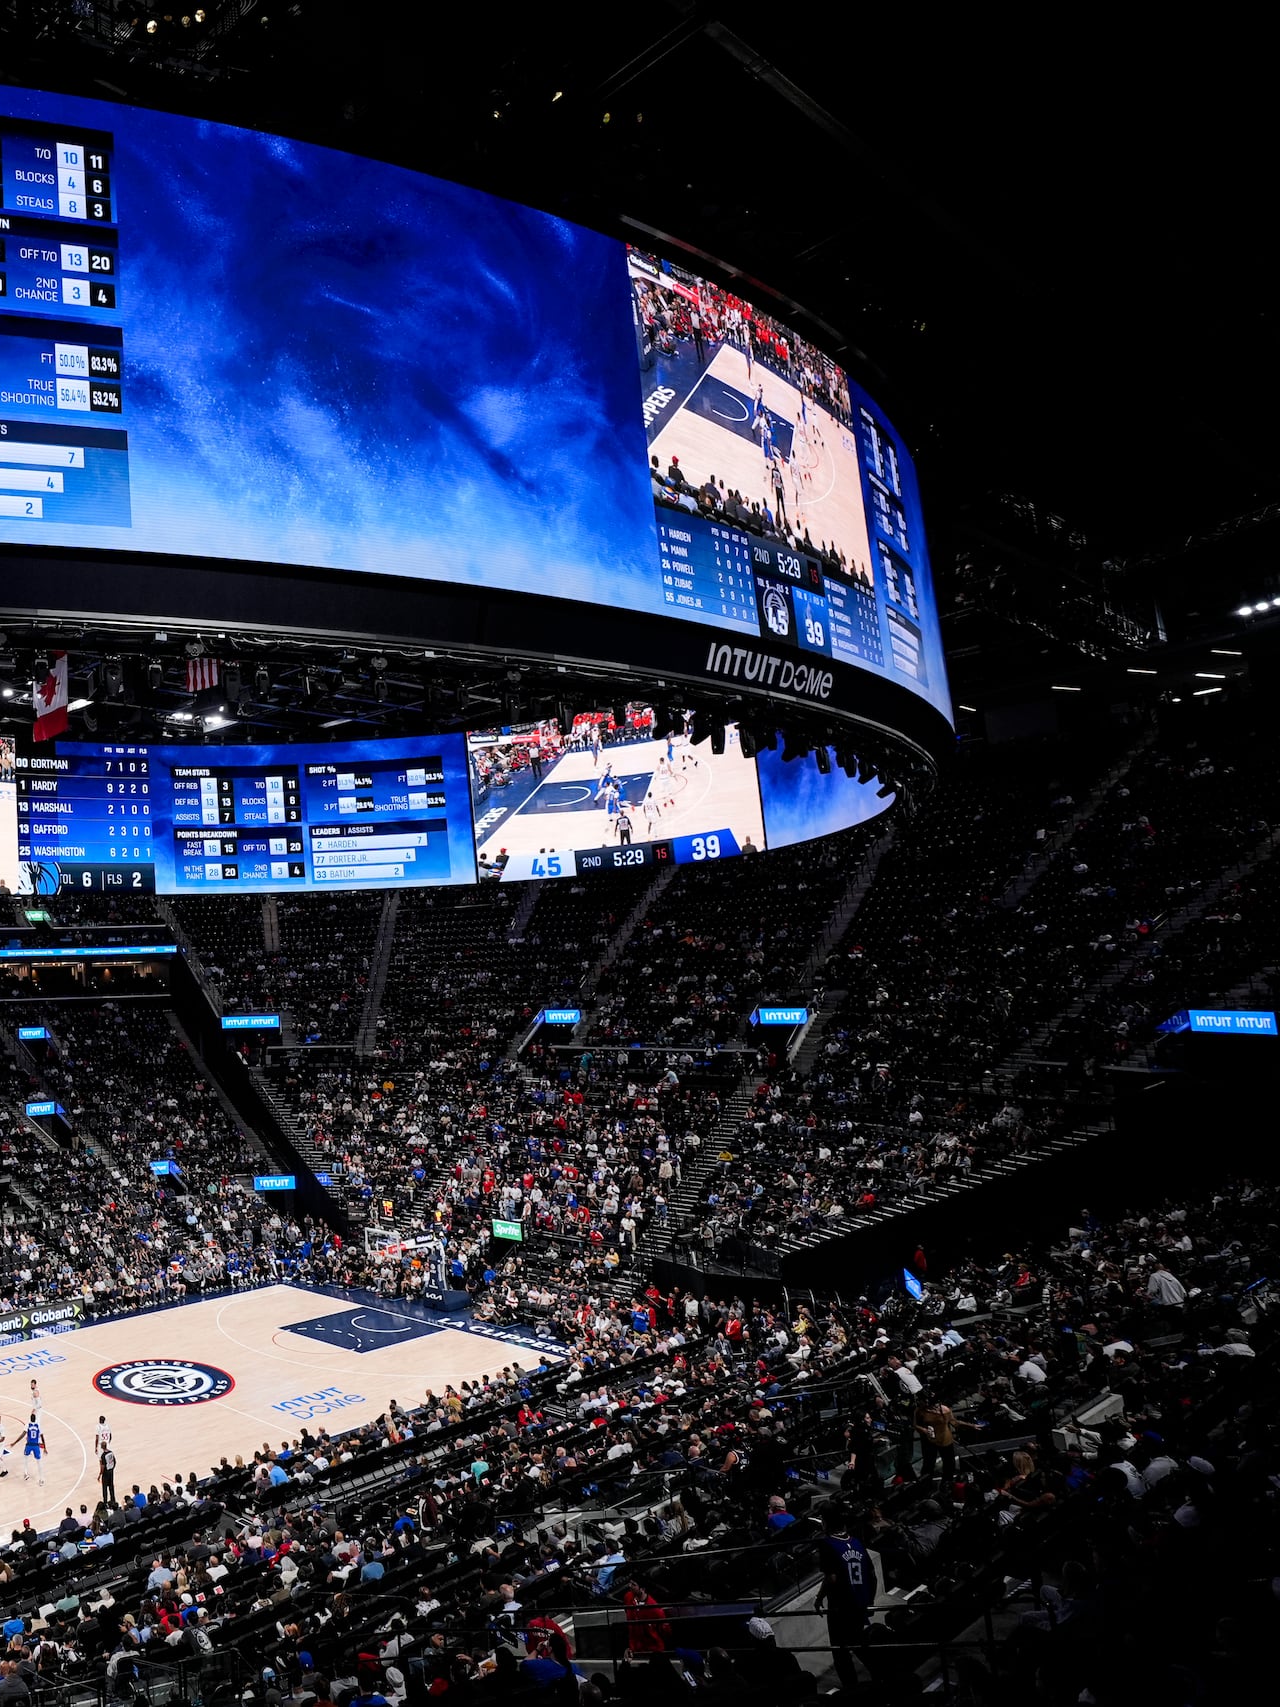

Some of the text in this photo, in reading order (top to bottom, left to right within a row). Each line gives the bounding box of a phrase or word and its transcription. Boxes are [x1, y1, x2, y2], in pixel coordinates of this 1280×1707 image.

[35, 148, 103, 169] T/O 10 11
[15, 170, 102, 194] BLOCKS 4 6
[16, 195, 103, 218] STEALS 8 3
[20, 248, 110, 271] OFF T/O 13 20
[36, 278, 58, 290] 2ND
[15, 287, 107, 303] CHANCE 3 4
[40, 353, 53, 364] FT
[27, 379, 54, 391] TRUE
[0, 391, 55, 406] SHOOTING
[68, 452, 75, 464] 7
[47, 477, 55, 489] 4
[25, 502, 33, 515] 2
[753, 547, 801, 579] 2ND 5:29
[767, 606, 789, 637] 45
[805, 617, 825, 647] 39
[705, 642, 782, 685] INTUIT
[31, 757, 68, 770] GORTMAN
[32, 802, 73, 814] MARSHALL
[34, 846, 85, 857] WASHINGTON
[530, 834, 721, 877] 45 5:29 39
[548, 1012, 576, 1021] INTUIT
[764, 1011, 802, 1022] INTUIT
[1195, 1014, 1273, 1031] INTUIT INTUIT
[495, 1223, 520, 1236] Sprite
[30, 1304, 74, 1325] Globant
[111, 1360, 195, 1374] ANGELES
[99, 1374, 112, 1390] LOS
[148, 1379, 228, 1405] CLIPPERS
[847, 1562, 863, 1585] 13
